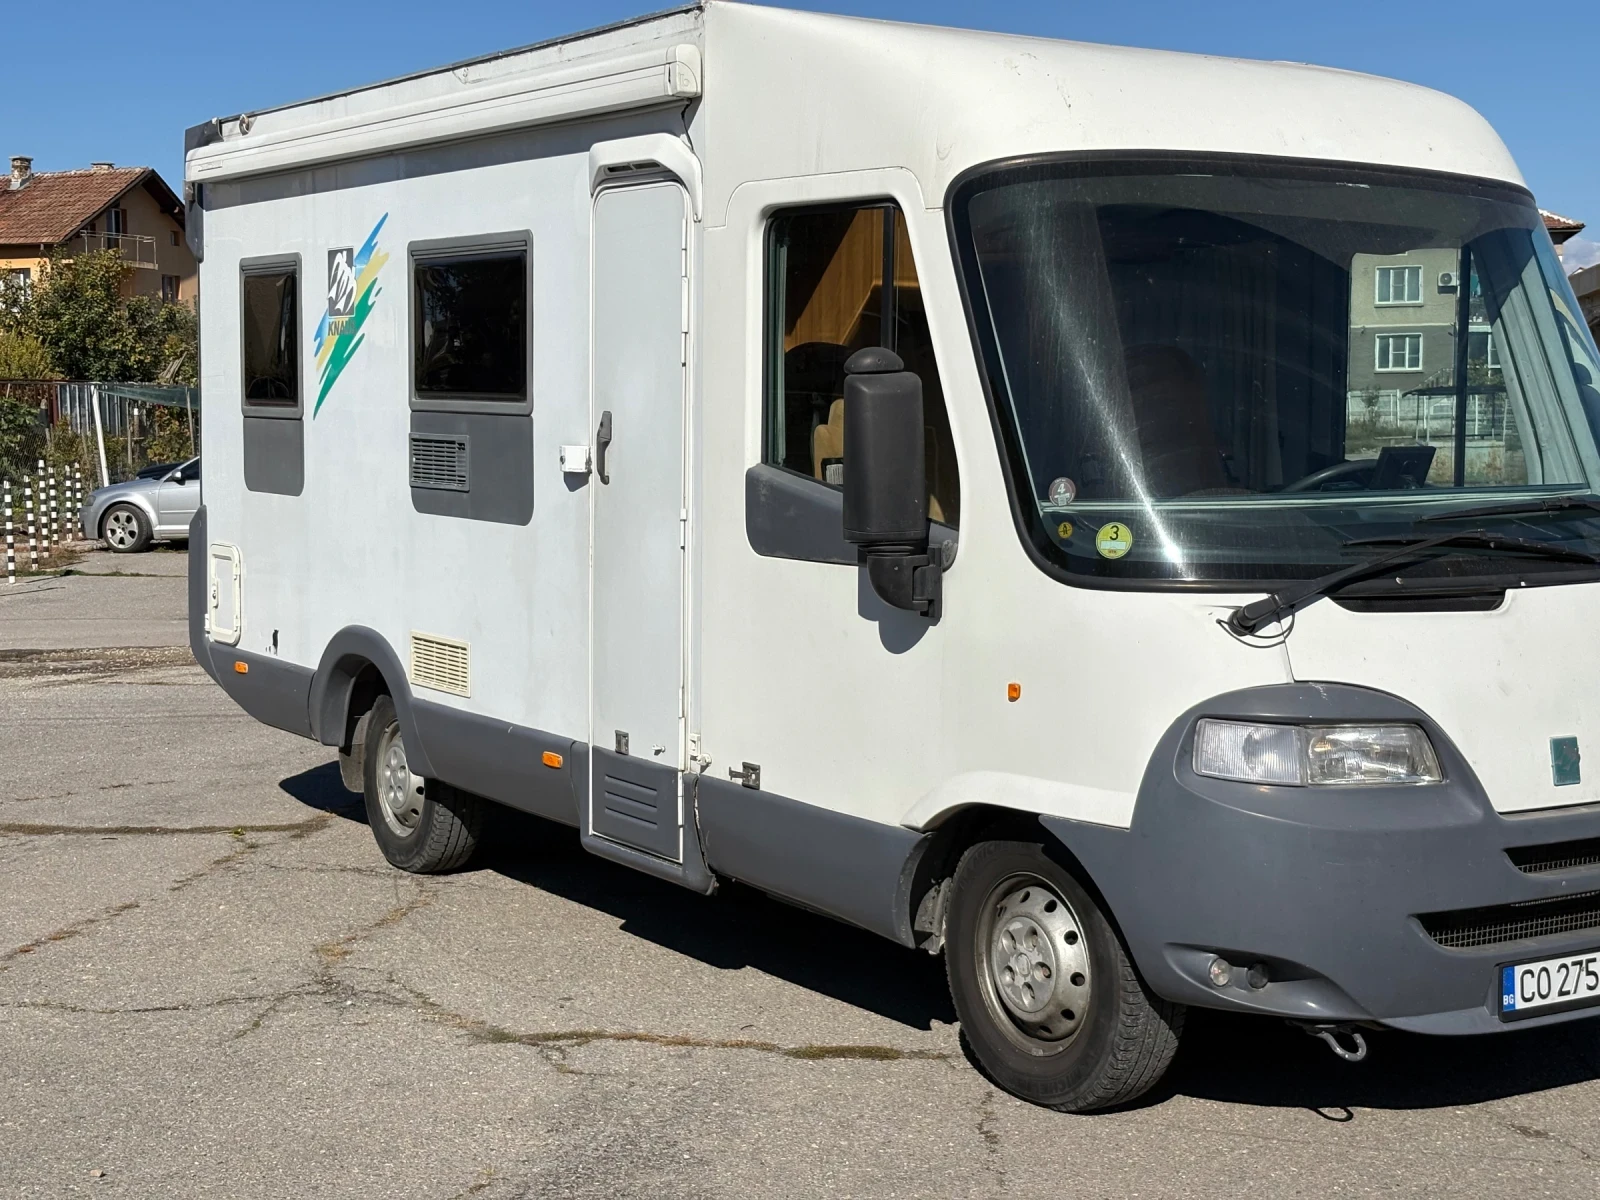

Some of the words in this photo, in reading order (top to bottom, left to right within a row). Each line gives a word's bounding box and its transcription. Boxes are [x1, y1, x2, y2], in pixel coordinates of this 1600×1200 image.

[1109, 525, 1119, 540] 3
[1520, 966, 1551, 1003] CO
[1556, 957, 1600, 996] 275
[1503, 994, 1514, 1006] BG
